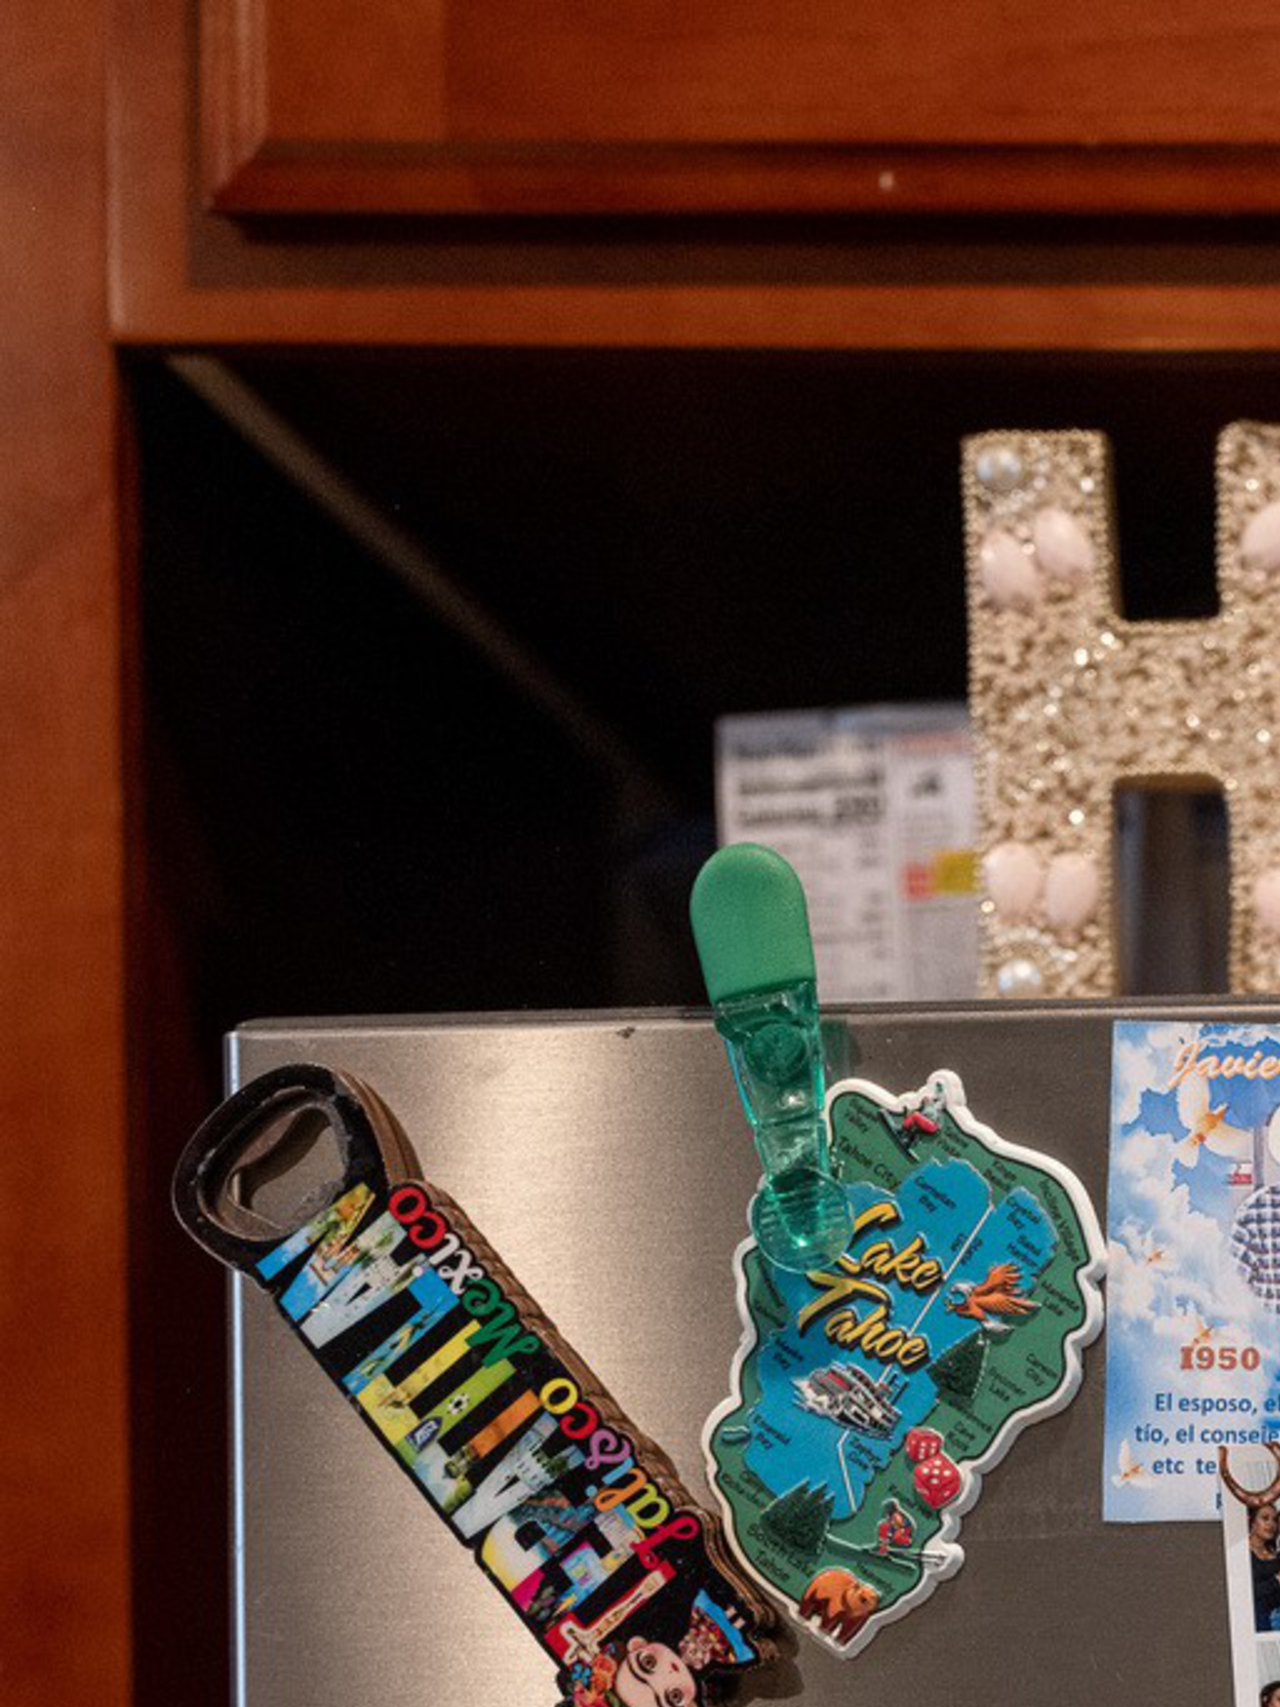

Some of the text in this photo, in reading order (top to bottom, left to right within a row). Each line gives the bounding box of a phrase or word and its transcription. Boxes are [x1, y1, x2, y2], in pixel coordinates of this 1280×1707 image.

[387, 1184, 540, 1370] Mexico
[839, 1200, 946, 1295] Lake
[797, 1269, 932, 1370] Tahoe
[1180, 1345, 1261, 1371] 1950
[254, 1182, 678, 1666] TEPATITLAN
[539, 1377, 701, 1569] Jalisco
